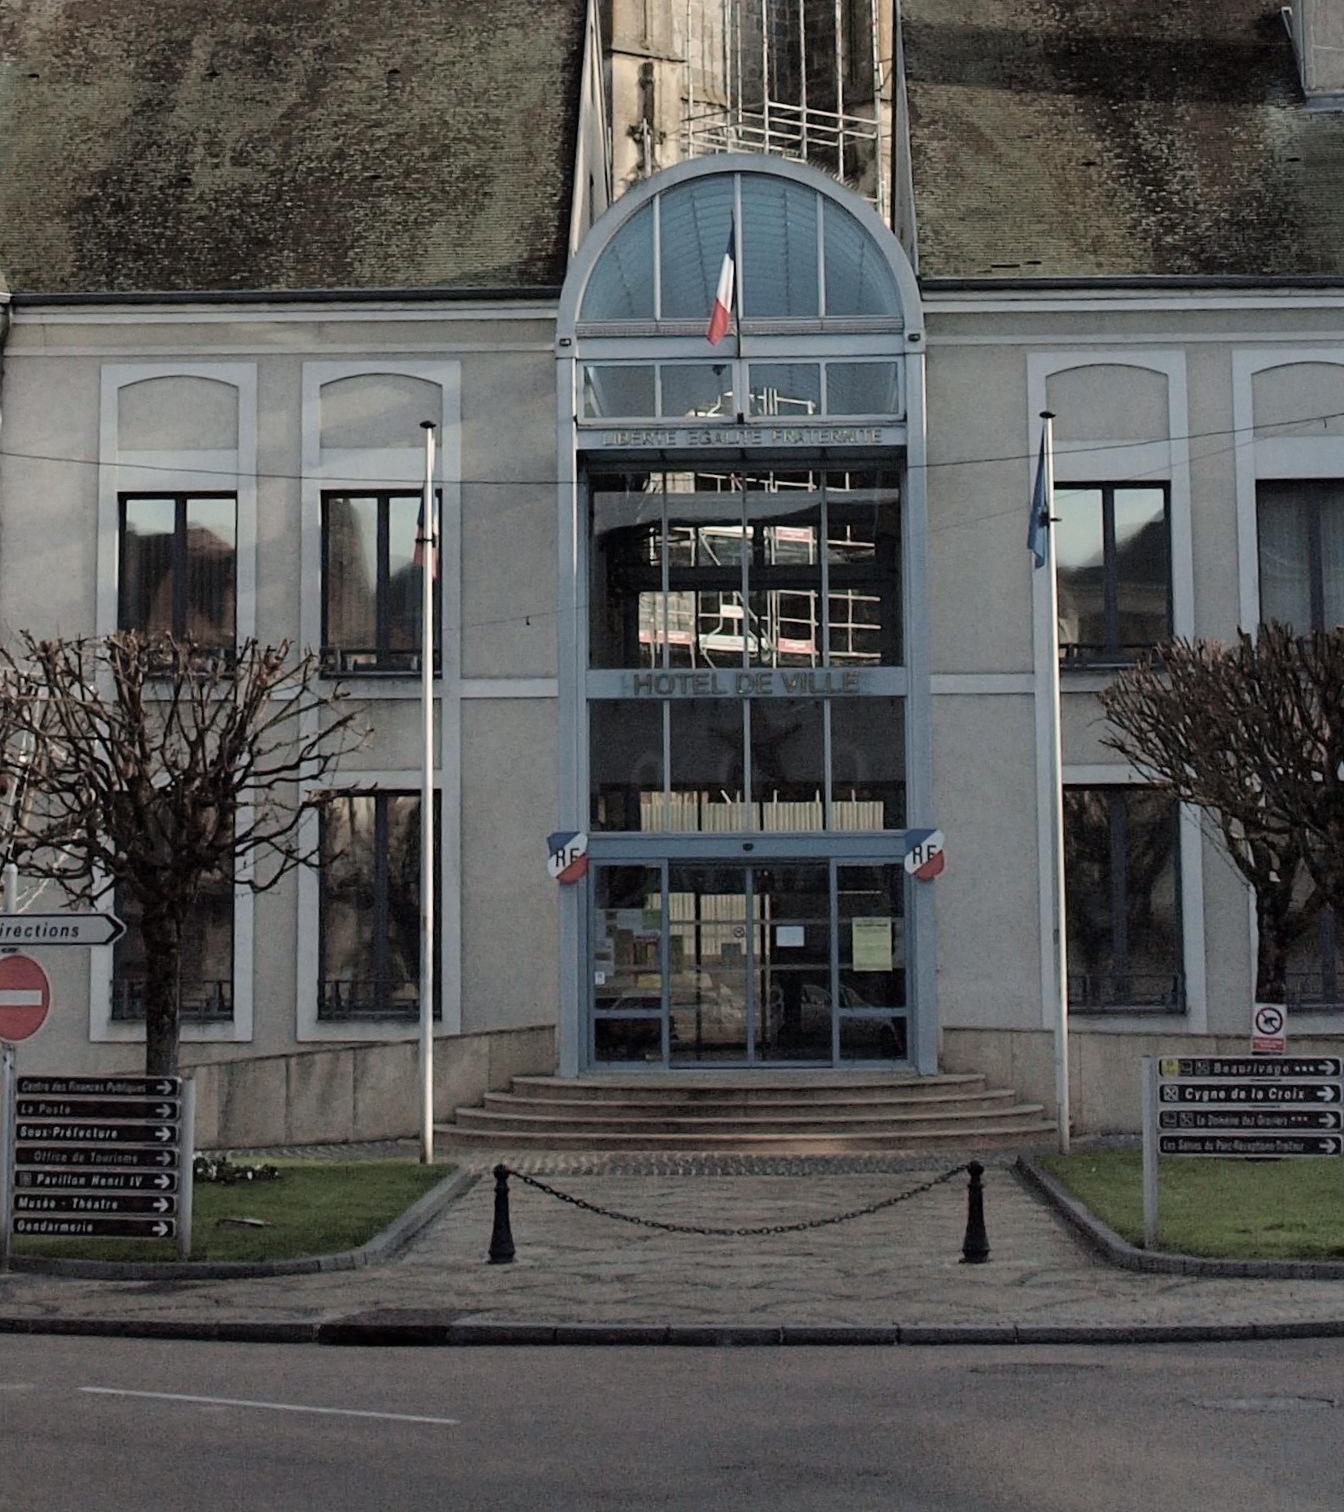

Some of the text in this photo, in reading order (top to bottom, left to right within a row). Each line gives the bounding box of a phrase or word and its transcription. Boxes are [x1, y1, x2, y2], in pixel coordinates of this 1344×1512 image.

[736, 672, 773, 695] DE
[780, 672, 860, 694] VILLE
[1185, 1089, 1226, 1102] Cygne
[1231, 1089, 1246, 1100] de
[1268, 1088, 1305, 1100] Croix
[21, 1104, 71, 1115] La Poste
[72, 1152, 85, 1163] de
[36, 1174, 86, 1185] Pavillon
[91, 1175, 124, 1186] Henri
[17, 1220, 93, 1232] Gendarmerie
